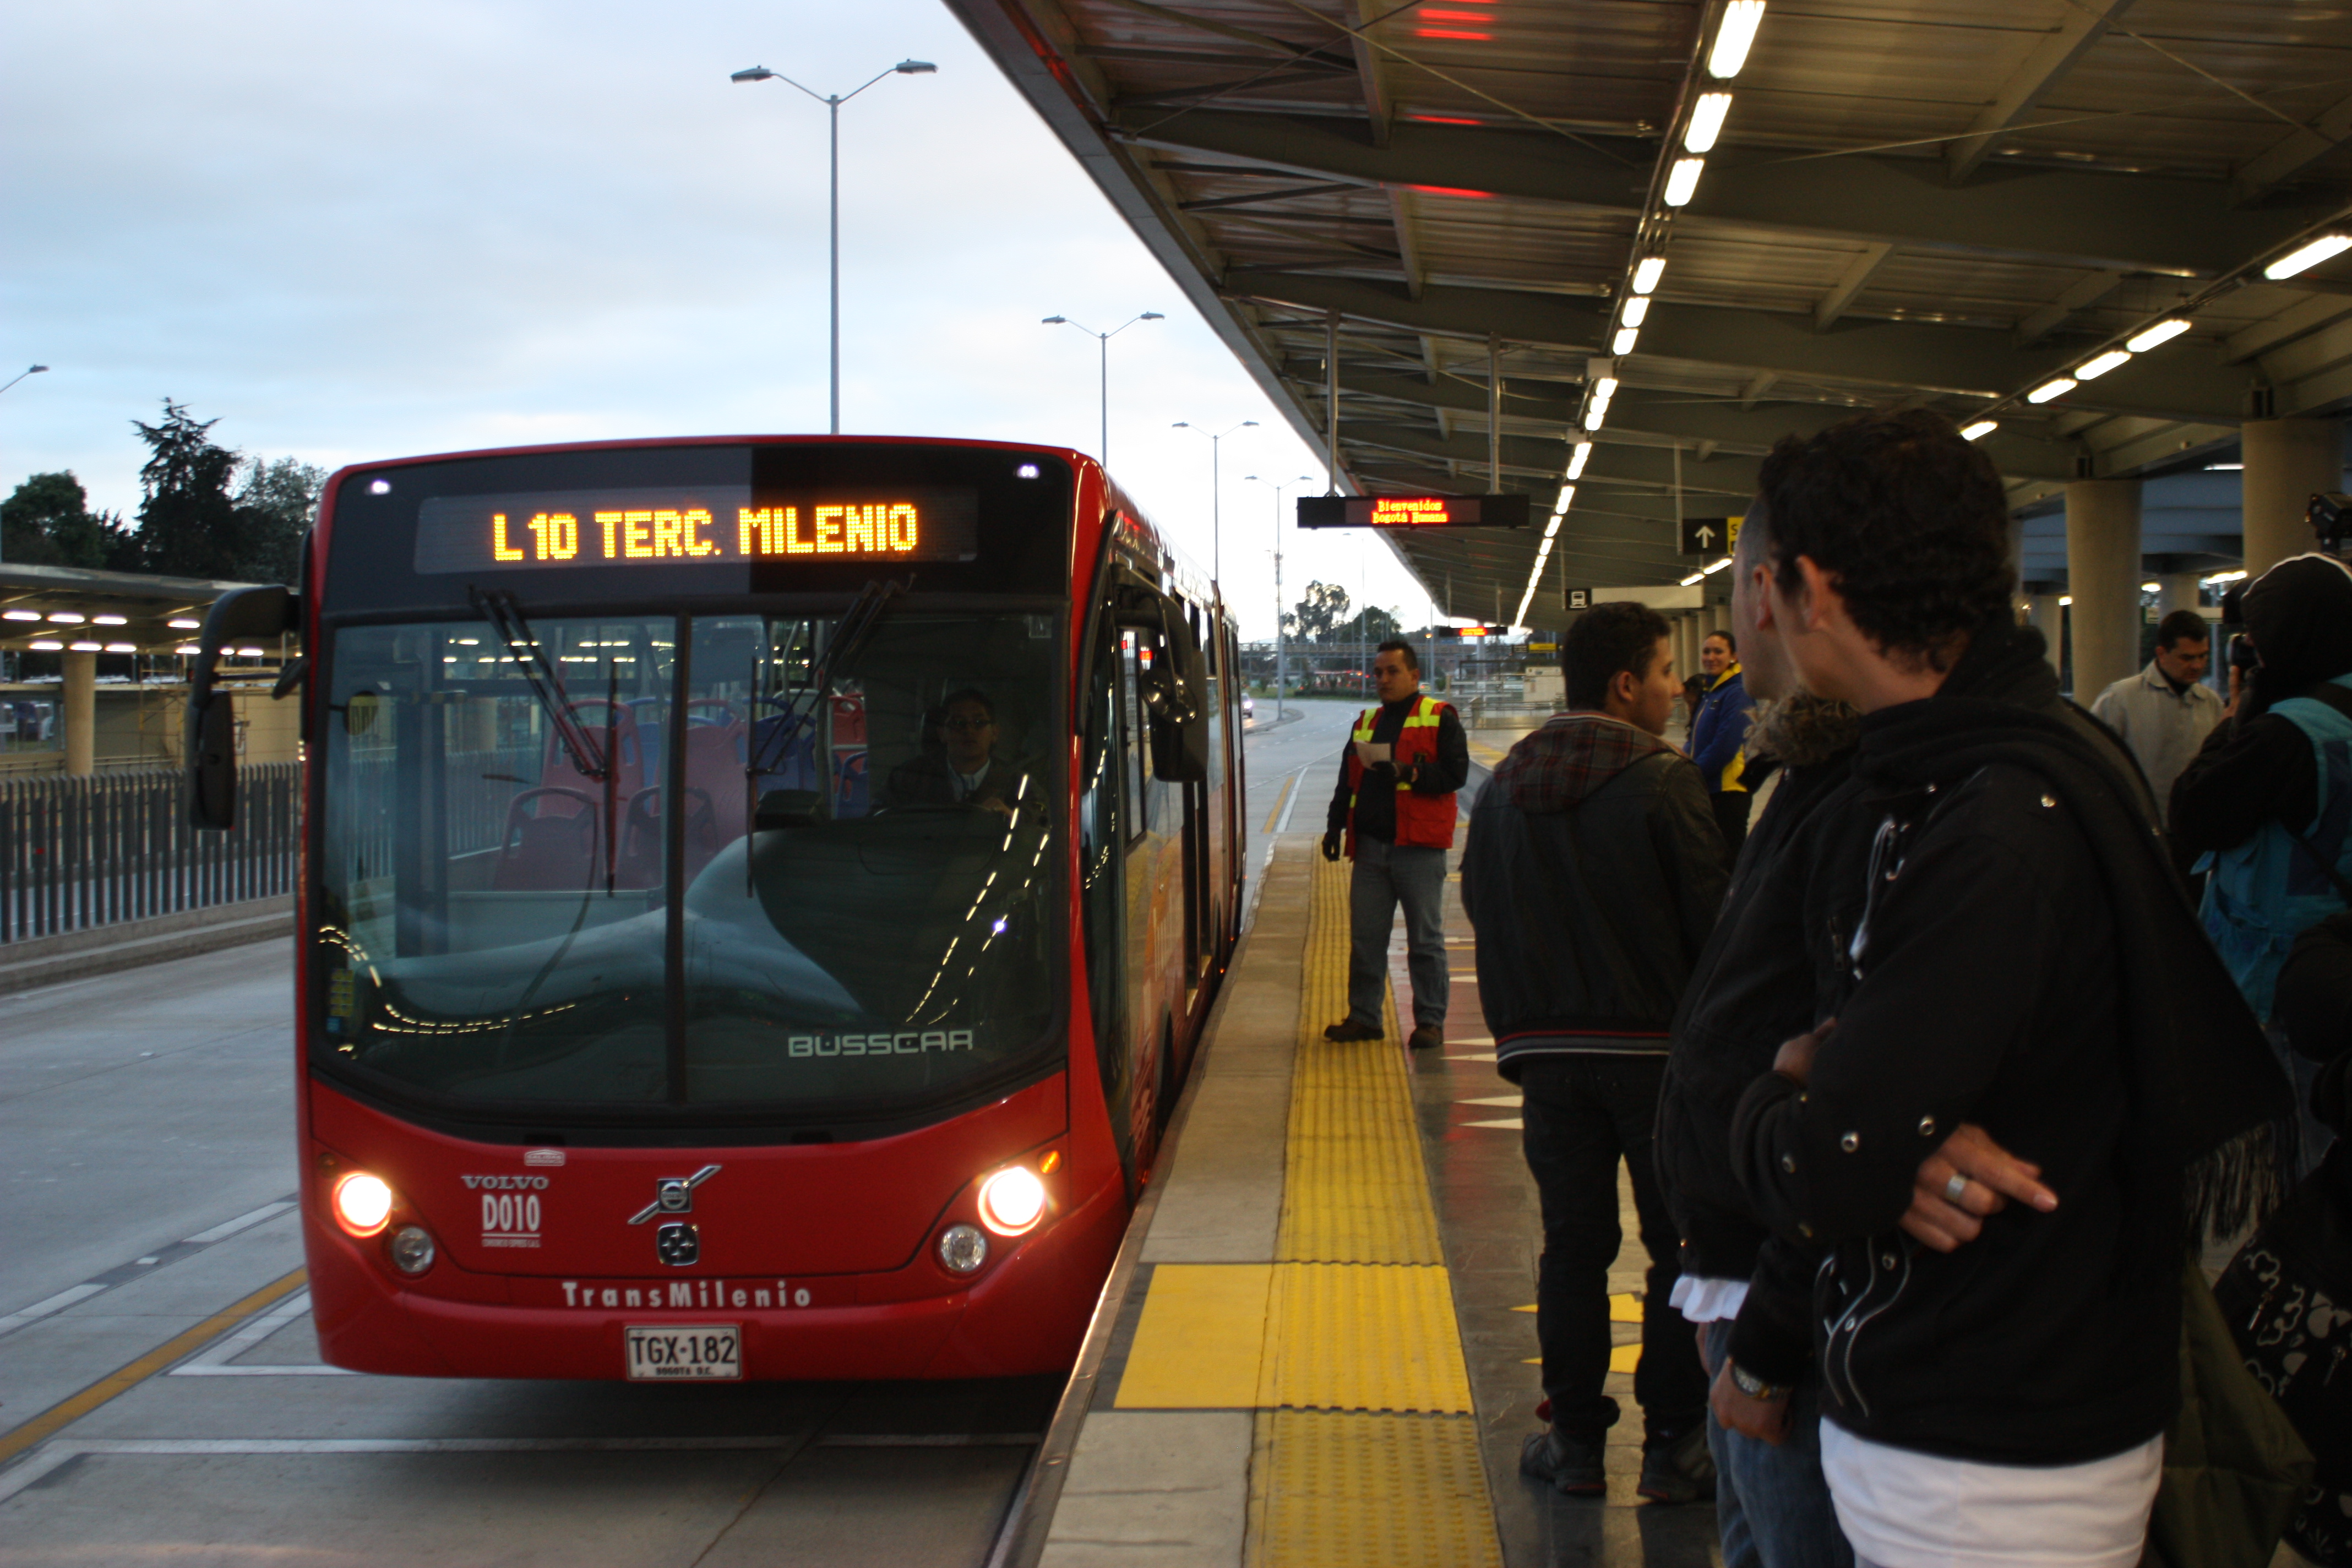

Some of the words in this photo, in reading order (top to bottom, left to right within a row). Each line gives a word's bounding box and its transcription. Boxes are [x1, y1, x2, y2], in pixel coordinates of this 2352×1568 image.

[1378, 500, 1442, 511] Bienvenidos
[494, 513, 577, 561] L10
[595, 510, 721, 558] TERC.
[739, 505, 917, 556] MILENIO
[788, 1030, 973, 1058] BUSSCAR
[460, 1176, 549, 1190] VOLVO
[562, 1281, 811, 1307] TransMilenio
